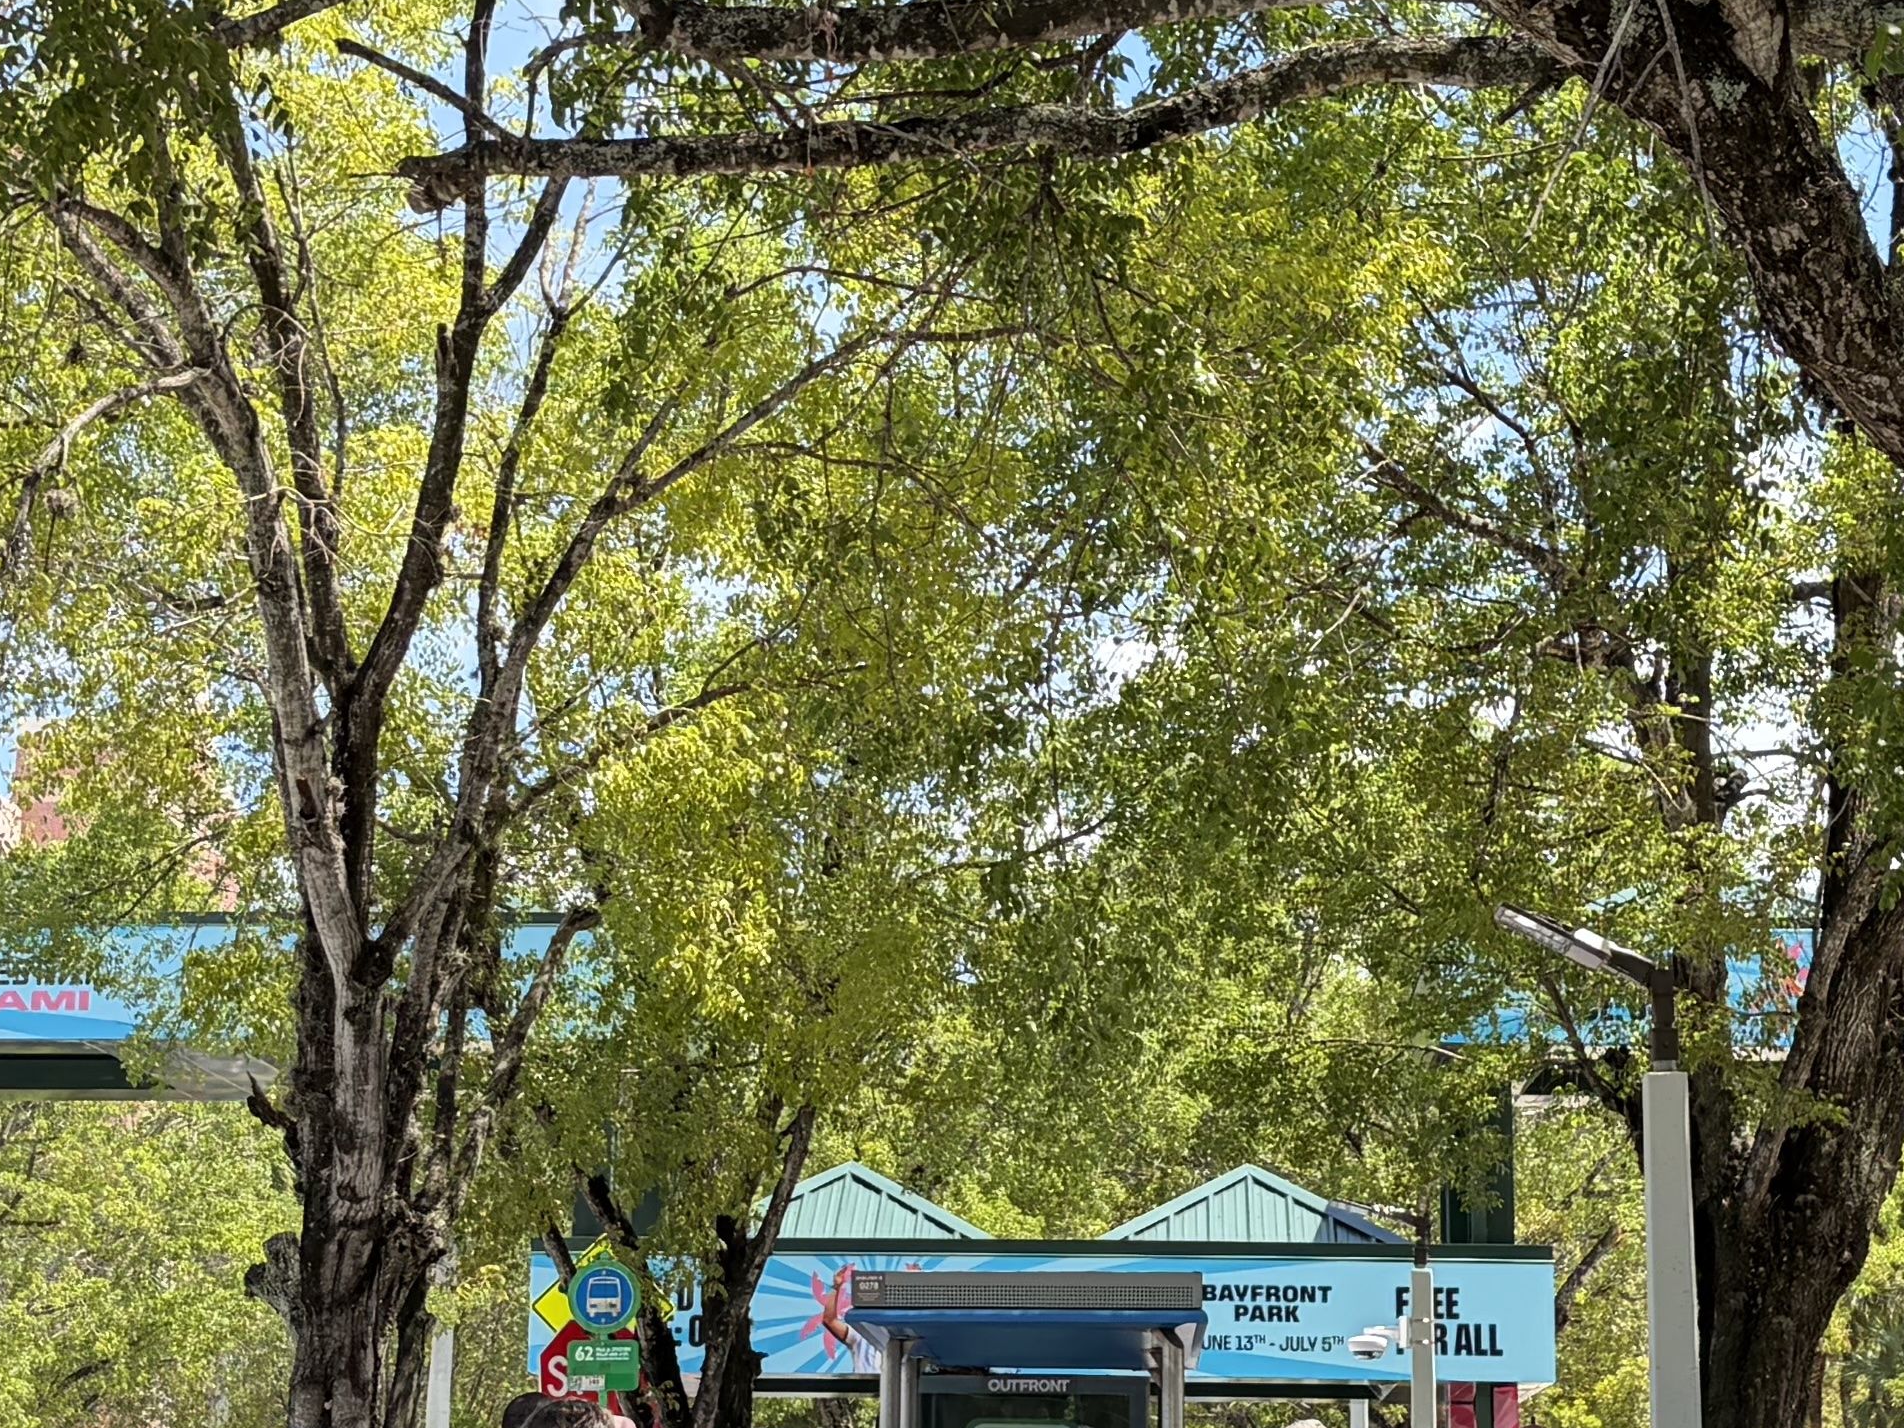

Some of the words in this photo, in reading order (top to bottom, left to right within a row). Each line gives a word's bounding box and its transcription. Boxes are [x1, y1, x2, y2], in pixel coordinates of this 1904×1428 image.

[1202, 1284, 1332, 1303] BAYFRONT
[1395, 1286, 1460, 1320] FEE
[1234, 1305, 1300, 1322] PARK
[1202, 1335, 1231, 1351] UNE
[1279, 1335, 1318, 1352] JULY
[1454, 1323, 1504, 1357] ALL
[574, 1346, 594, 1362] 62
[988, 1379, 1070, 1393] OUTFRONT
